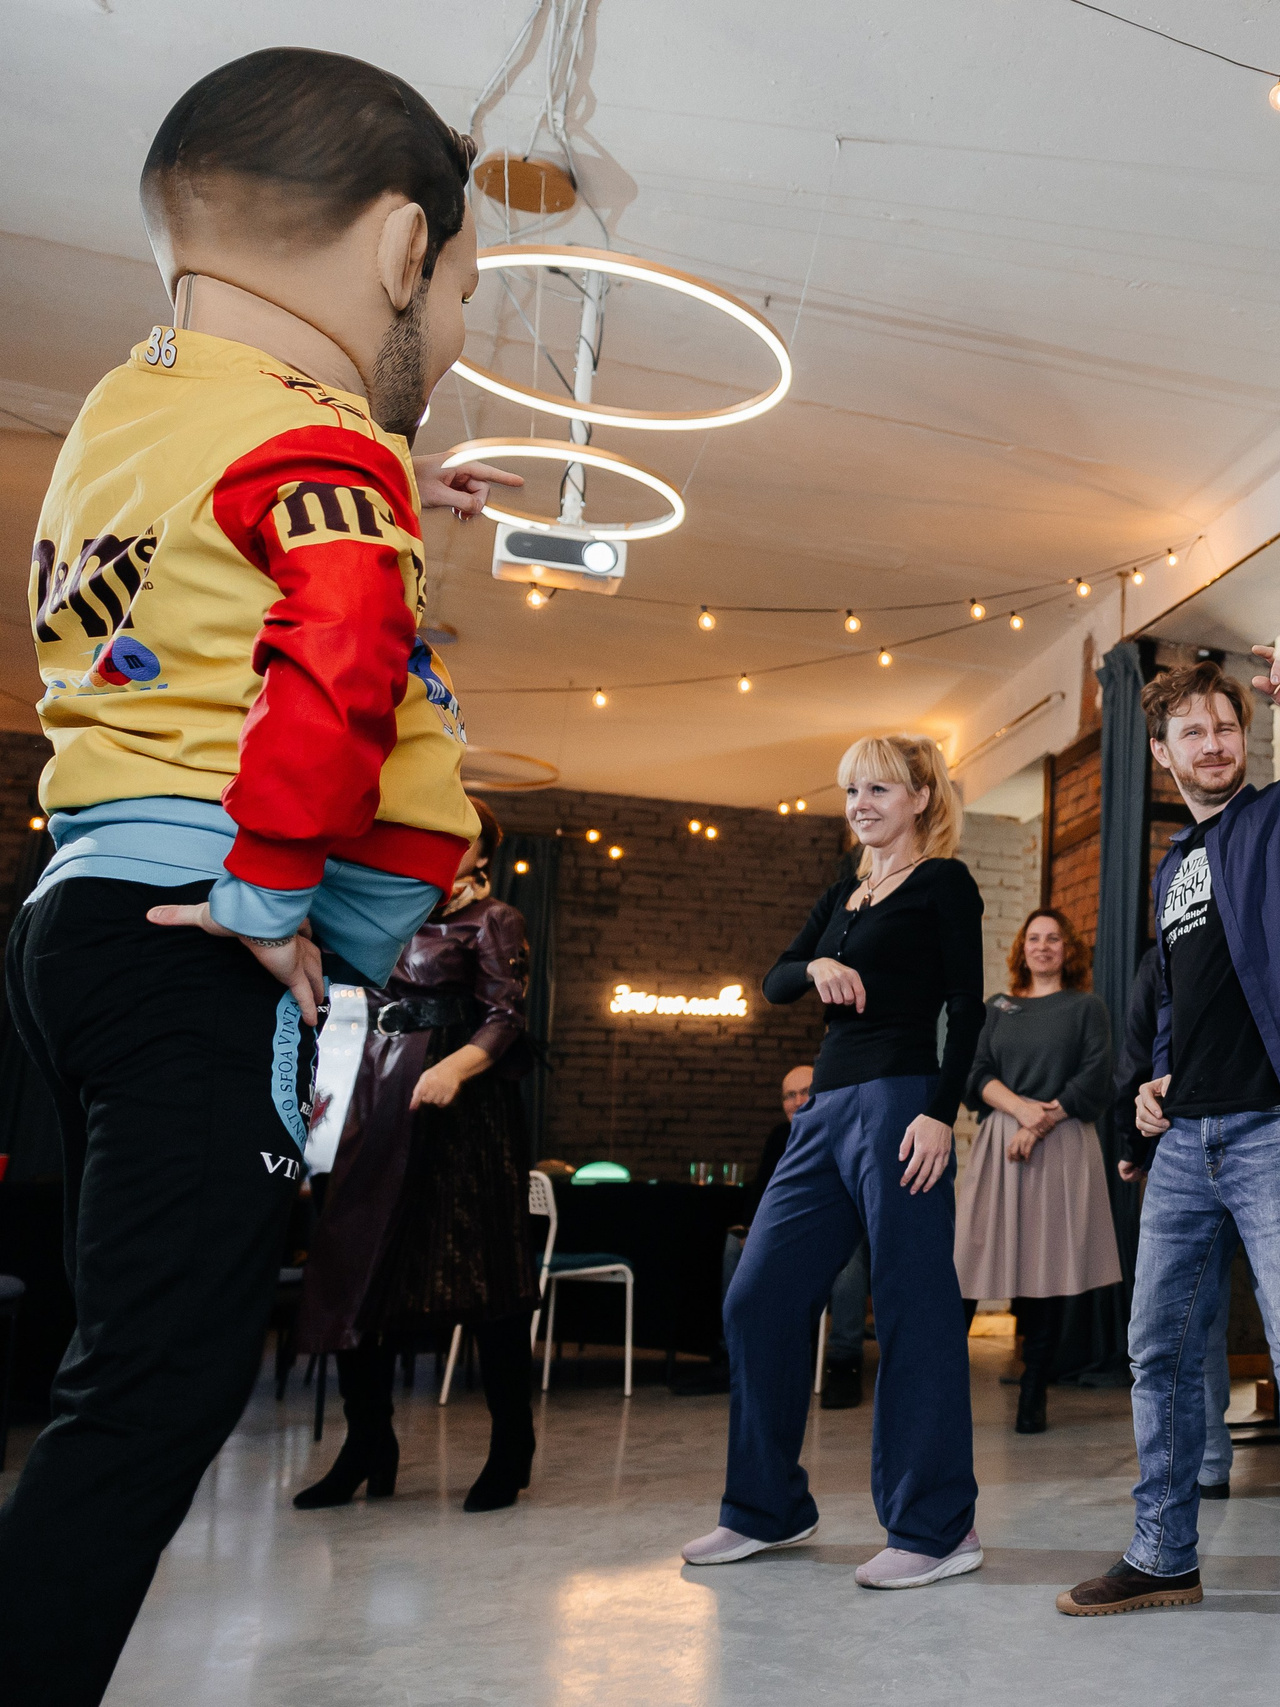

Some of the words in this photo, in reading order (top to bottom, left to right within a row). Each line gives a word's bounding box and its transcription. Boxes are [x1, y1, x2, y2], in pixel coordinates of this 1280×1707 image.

[144, 326, 178, 369] 36
[277, 1000, 300, 1046] VINTA
[282, 1099, 306, 1144] ENTO
[259, 1151, 300, 1181] VIN
